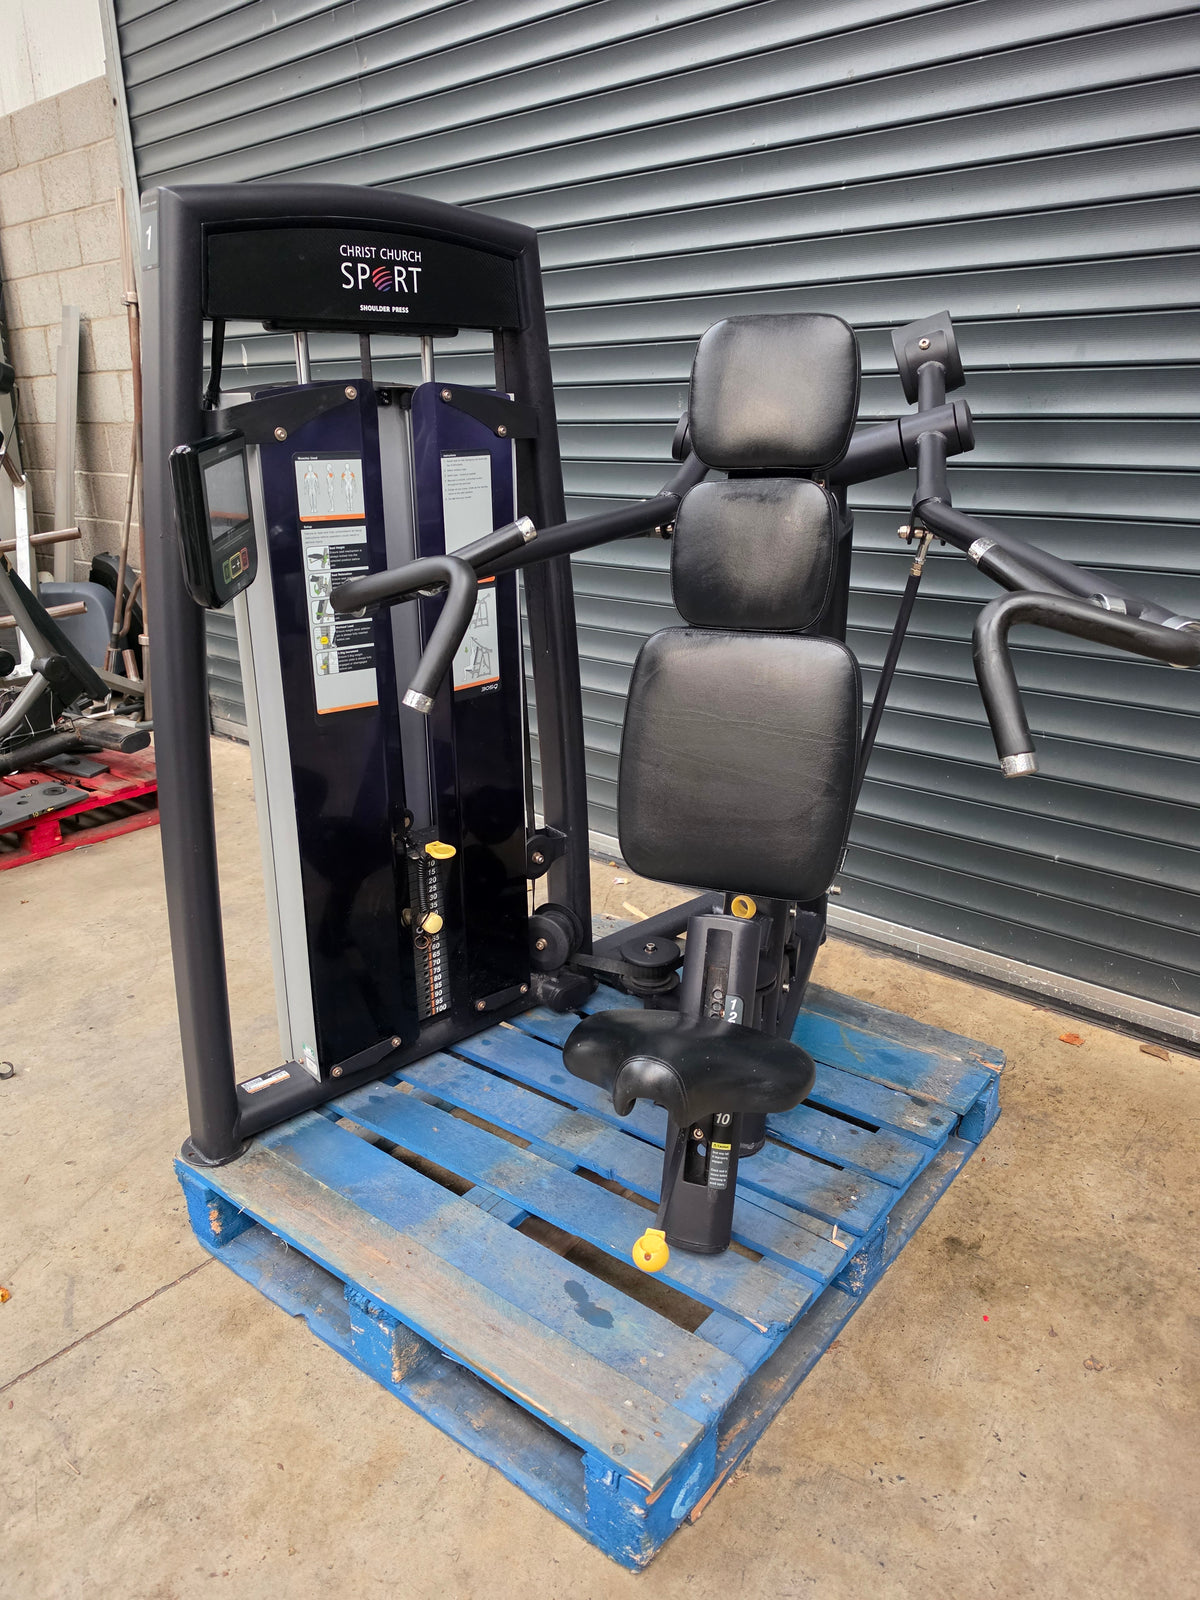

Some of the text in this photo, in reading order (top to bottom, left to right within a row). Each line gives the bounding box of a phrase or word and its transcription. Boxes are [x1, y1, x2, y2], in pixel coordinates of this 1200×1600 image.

[145, 225, 152, 250] 1
[339, 244, 422, 262] CHRIST CHURCH
[340, 262, 422, 293] SPORT
[360, 304, 409, 314] SHOULDER PRESS
[428, 876, 437, 884] 20
[428, 884, 437, 892] 25
[429, 893, 438, 901] 30
[429, 901, 438, 909] 35
[432, 942, 440, 950] 60
[432, 950, 440, 958] 65
[433, 958, 441, 966] 70
[433, 966, 441, 974] 75
[434, 981, 442, 989] 85
[434, 989, 443, 997] 90
[436, 1003, 447, 1013] 100
[730, 998, 737, 1010] 1
[727, 1011, 738, 1023] 2
[716, 1112, 731, 1125] 10
